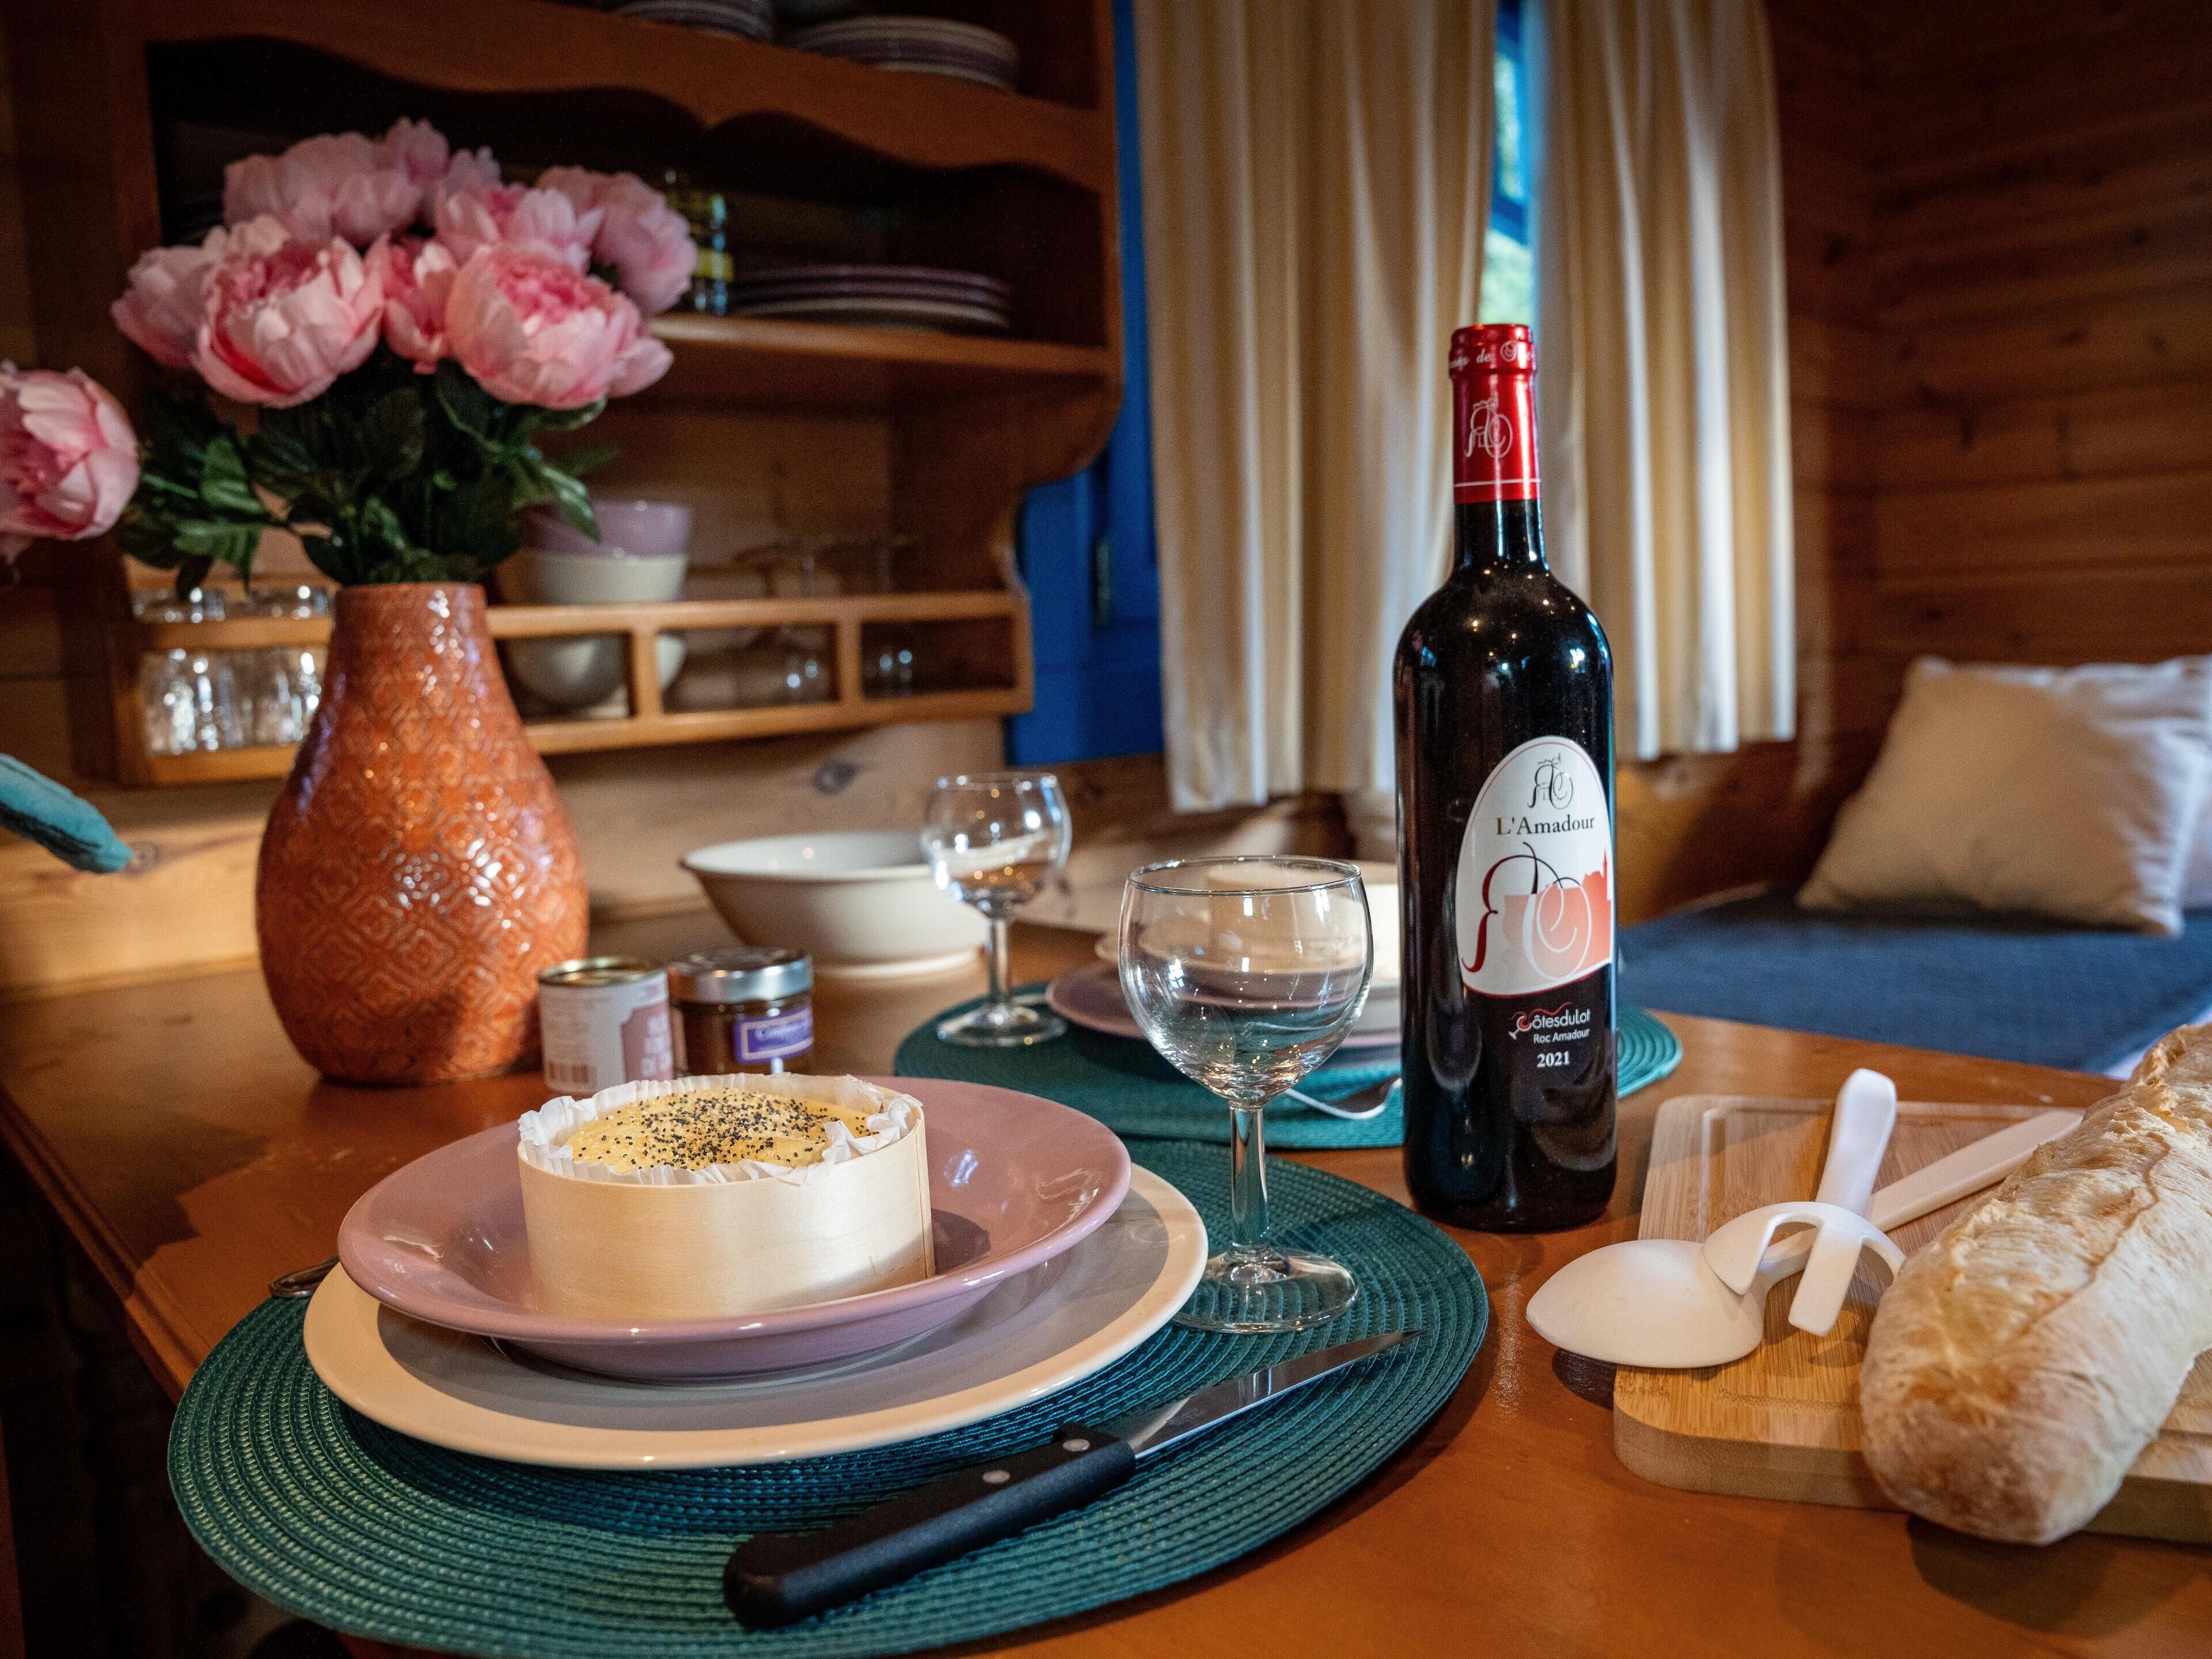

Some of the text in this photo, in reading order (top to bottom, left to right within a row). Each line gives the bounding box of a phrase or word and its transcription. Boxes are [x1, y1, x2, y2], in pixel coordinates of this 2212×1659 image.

[1495, 813, 1594, 836] L'Amadour
[1533, 1028, 1591, 1044] Roc Amadour
[1536, 1050, 1570, 1068] 2021
